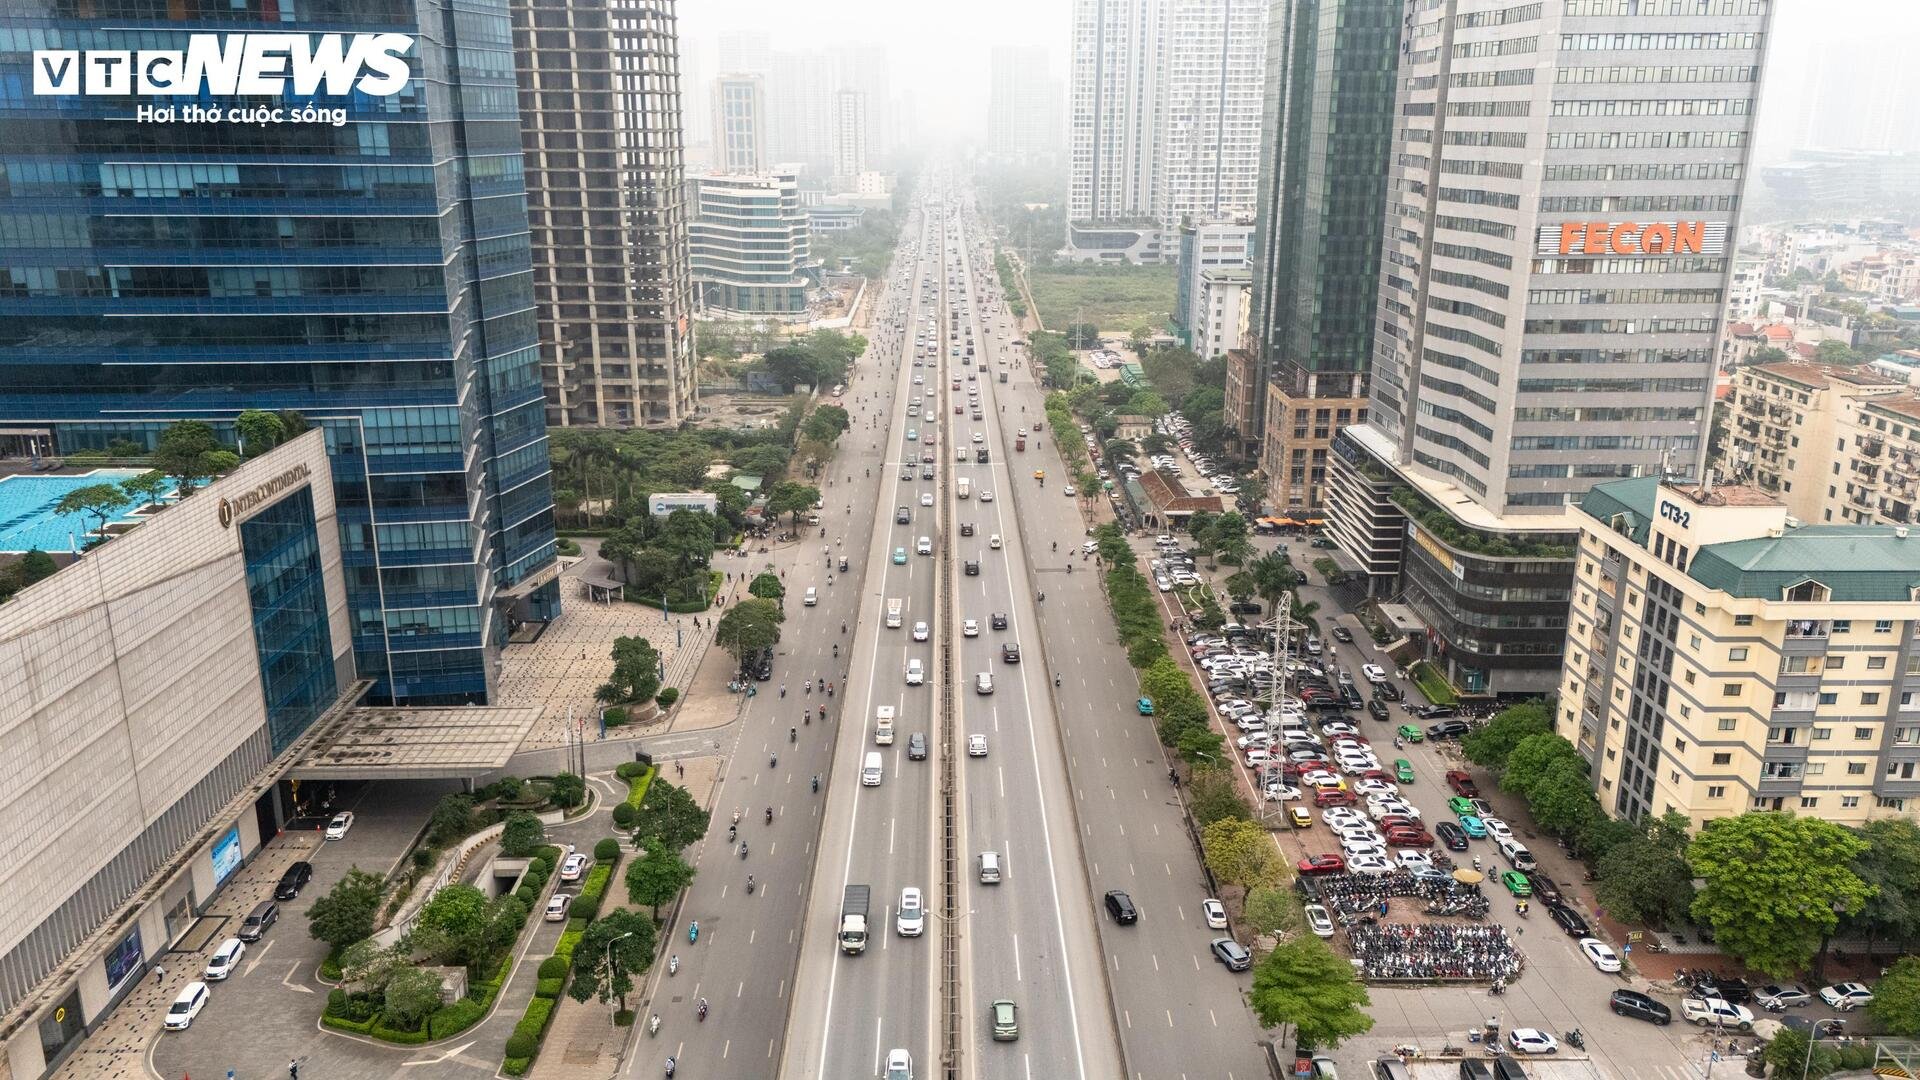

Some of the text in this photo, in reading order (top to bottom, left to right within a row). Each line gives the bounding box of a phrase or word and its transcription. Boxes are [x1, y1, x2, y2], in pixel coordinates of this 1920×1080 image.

[1559, 221, 1705, 254] FECON
[232, 462, 312, 517] INTERCONTINENTAL
[1661, 500, 1690, 529] CT3-2
